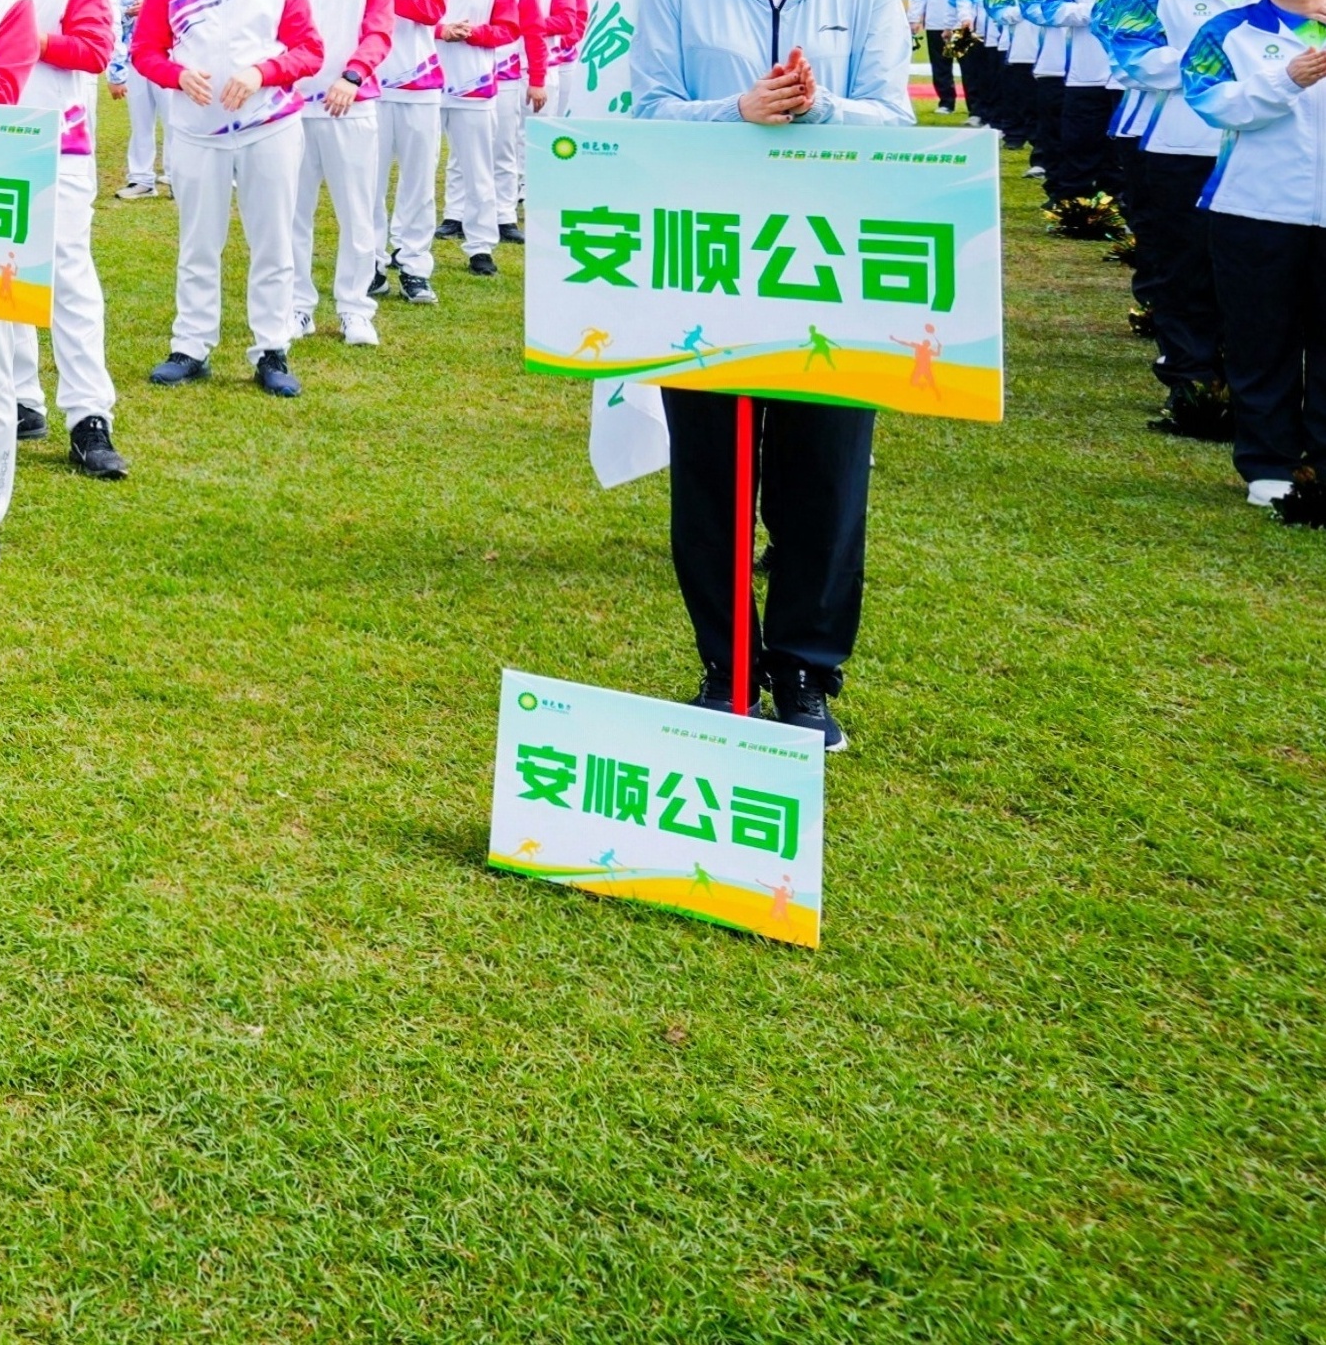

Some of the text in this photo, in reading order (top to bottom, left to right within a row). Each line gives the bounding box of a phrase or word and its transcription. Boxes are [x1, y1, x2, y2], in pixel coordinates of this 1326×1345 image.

[559, 205, 957, 313] 安顺公司
[515, 744, 800, 862] 安顺公司
